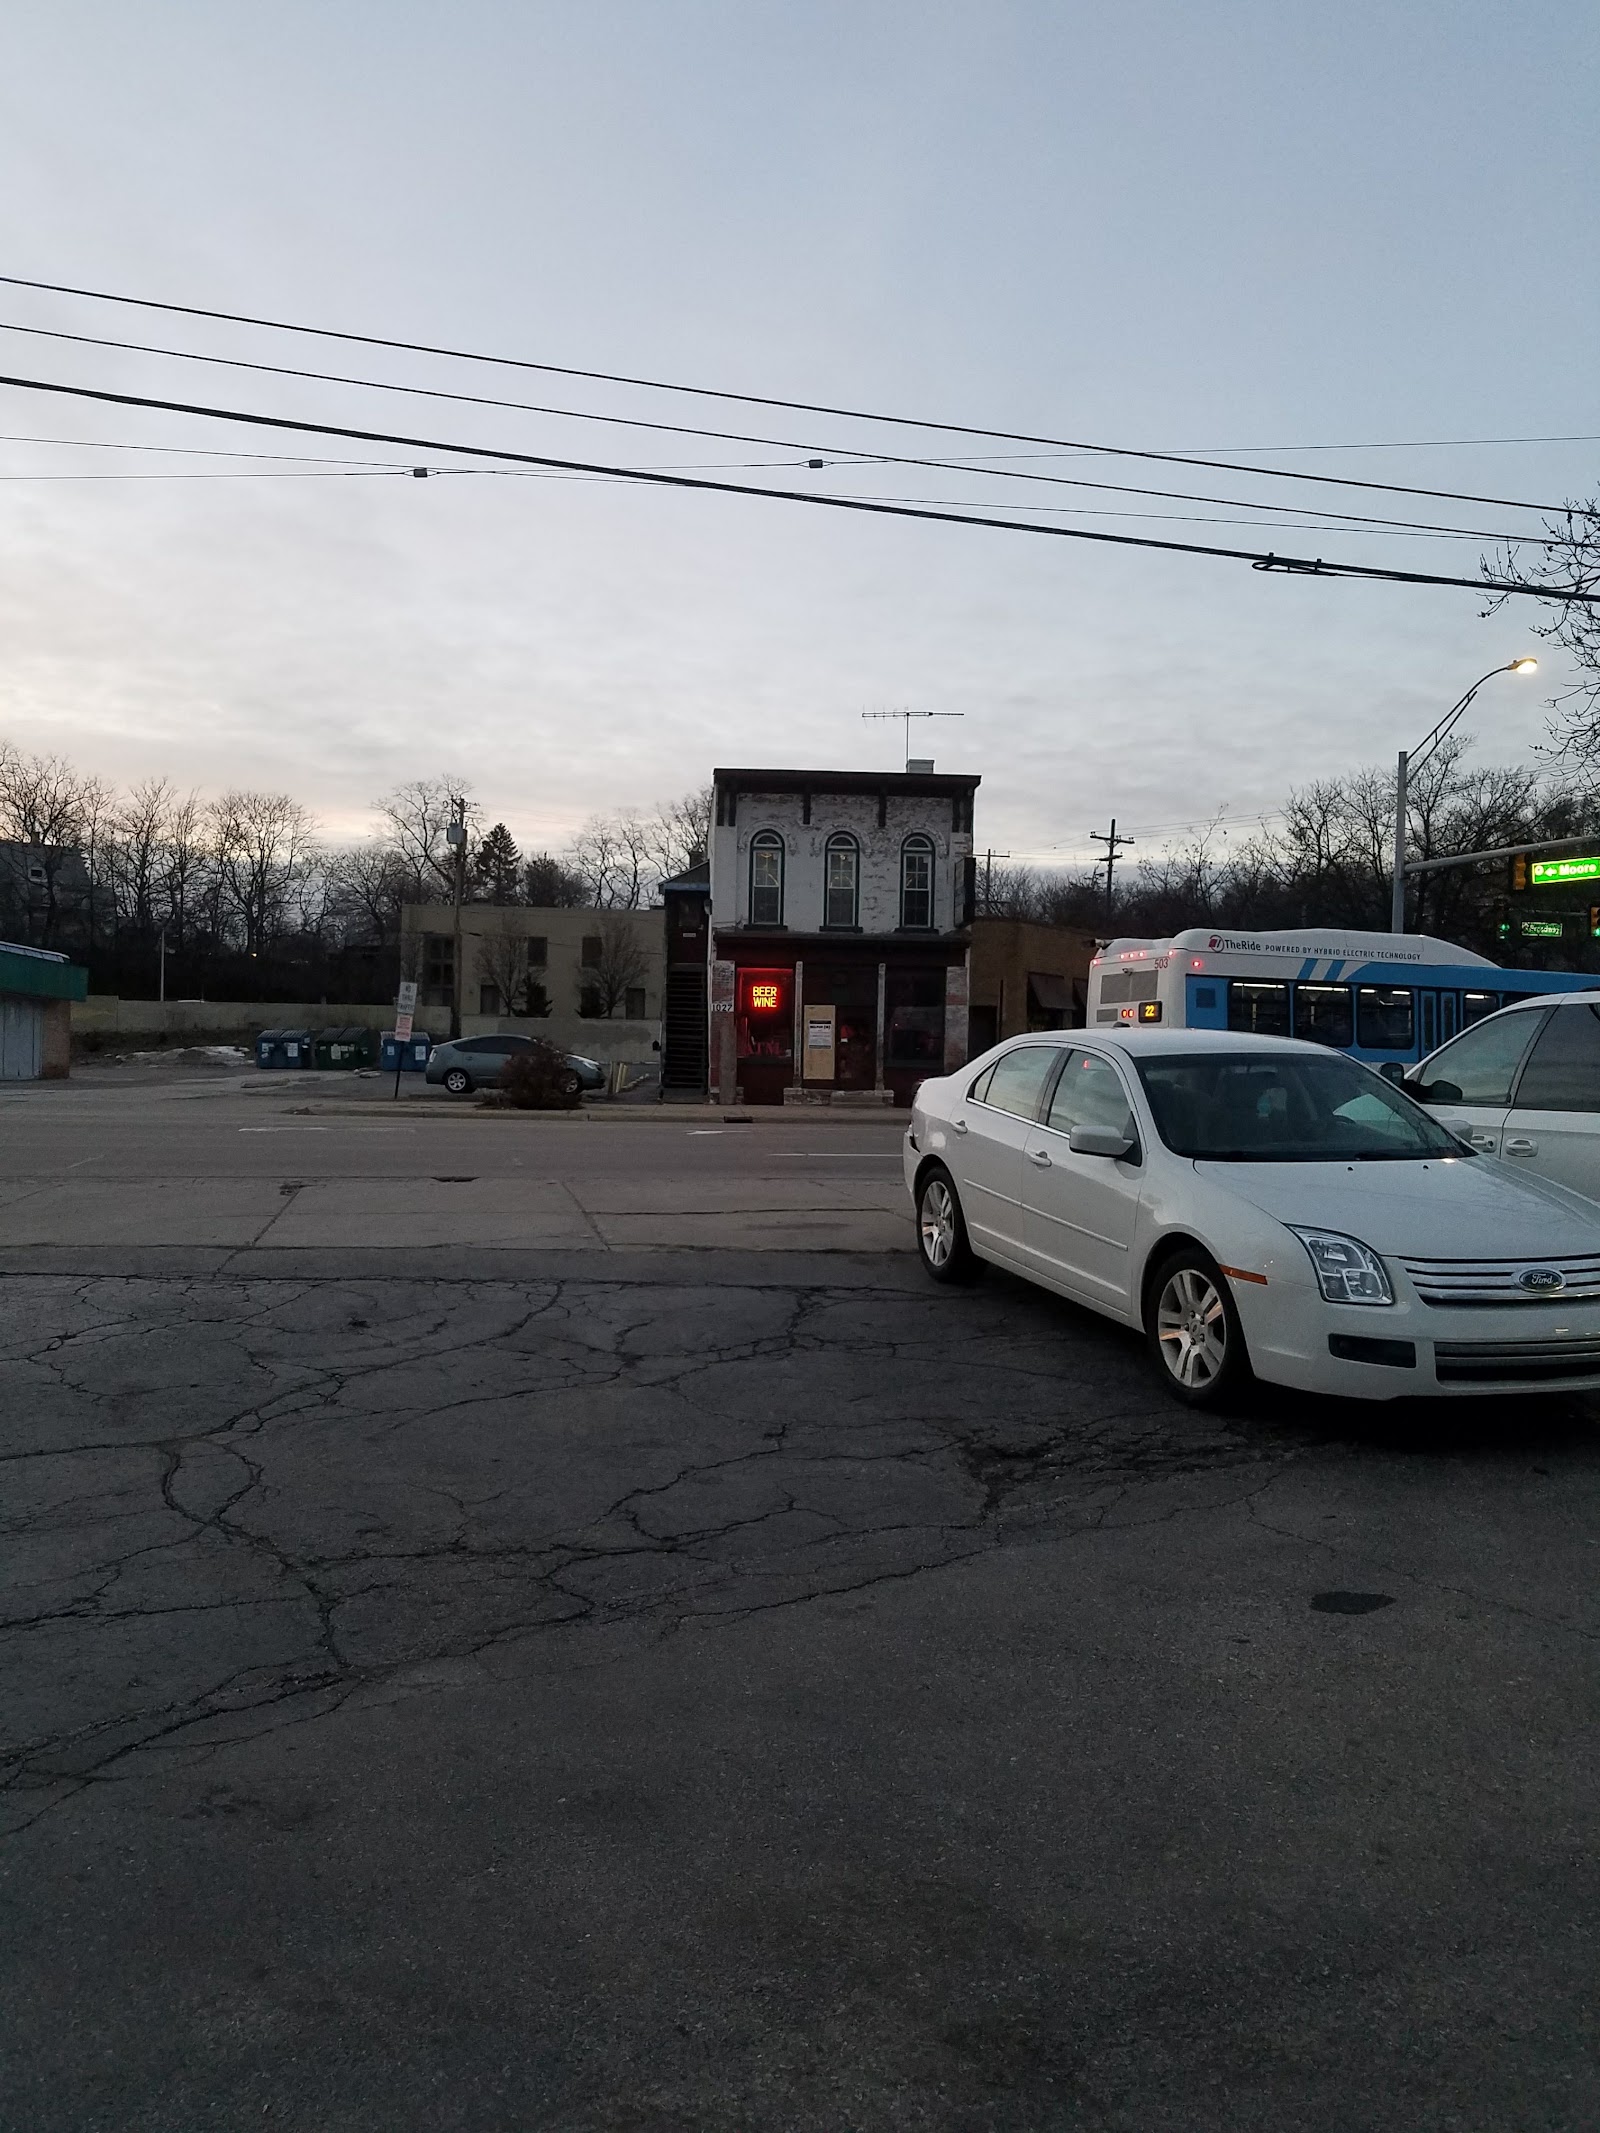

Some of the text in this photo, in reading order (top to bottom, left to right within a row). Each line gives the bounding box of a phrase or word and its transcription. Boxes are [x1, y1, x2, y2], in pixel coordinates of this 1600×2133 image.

[1559, 863, 1597, 876] Moore
[1224, 939, 1421, 960] TheRide POWERED BY HYBRID ELECTRIC TECHNOLOGY
[1154, 958, 1169, 969] 503
[753, 986, 777, 997] BEER
[712, 1003, 733, 1012] 1027
[753, 996, 777, 1008] WINE
[1144, 1004, 1155, 1017] 22
[1531, 1273, 1553, 1285] Ford
